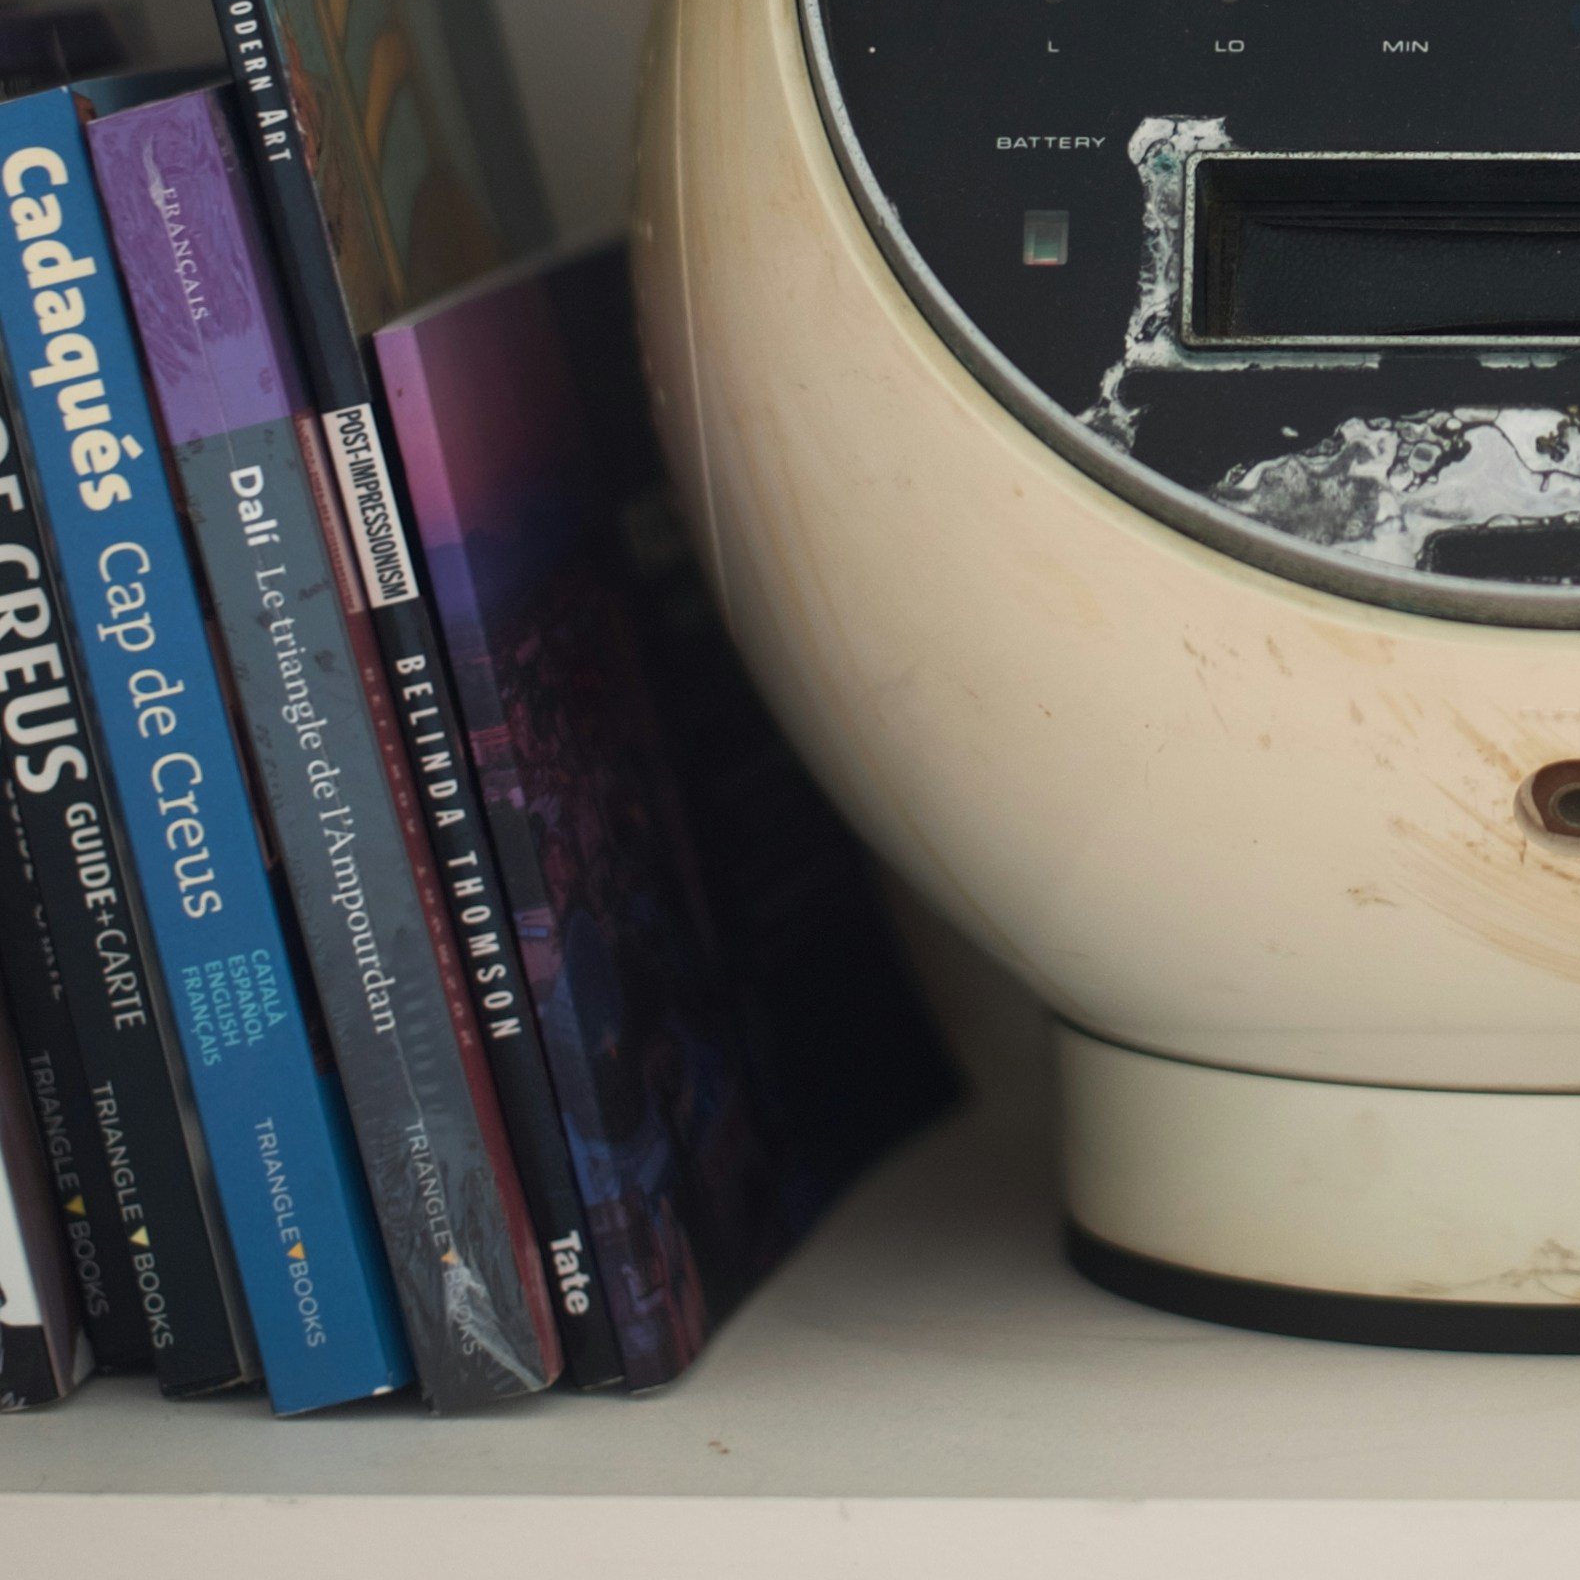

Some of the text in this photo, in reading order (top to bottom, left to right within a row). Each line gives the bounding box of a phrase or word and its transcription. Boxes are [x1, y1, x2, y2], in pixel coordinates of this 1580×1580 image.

[1047, 40, 1060, 53] L
[1214, 40, 1246, 54] LO
[1382, 40, 1429, 54] MIN
[258, 109, 292, 163] ART
[996, 136, 1106, 150] BATTERY
[161, 187, 209, 321] FRANÇAIS
[3, 147, 223, 920] Cadaqués Cap de Creus
[229, 464, 280, 547] Dalí
[336, 408, 409, 601] POST-IMPRESSIONISM
[256, 565, 286, 610] Le
[0, 542, 88, 793] CREUS
[270, 615, 328, 750] triangle
[308, 756, 341, 799] de
[396, 654, 465, 828] BELINDA
[447, 851, 521, 1038] THOMSON
[182, 965, 222, 1066] FRANÇAIS
[204, 960, 241, 1047] ENGLISH
[227, 954, 264, 1047] ESPAÑOL
[251, 949, 287, 1027] CATALÀ
[29, 1050, 81, 1193] TRIANGLE
[68, 1219, 110, 1317] BOOKS
[93, 1081, 174, 1349] TRIANGLE BOOKS
[404, 1118, 453, 1248] TRIANGLE
[254, 1117, 325, 1347] TRIANGLE BOOKS
[548, 1230, 590, 1316] Tate
